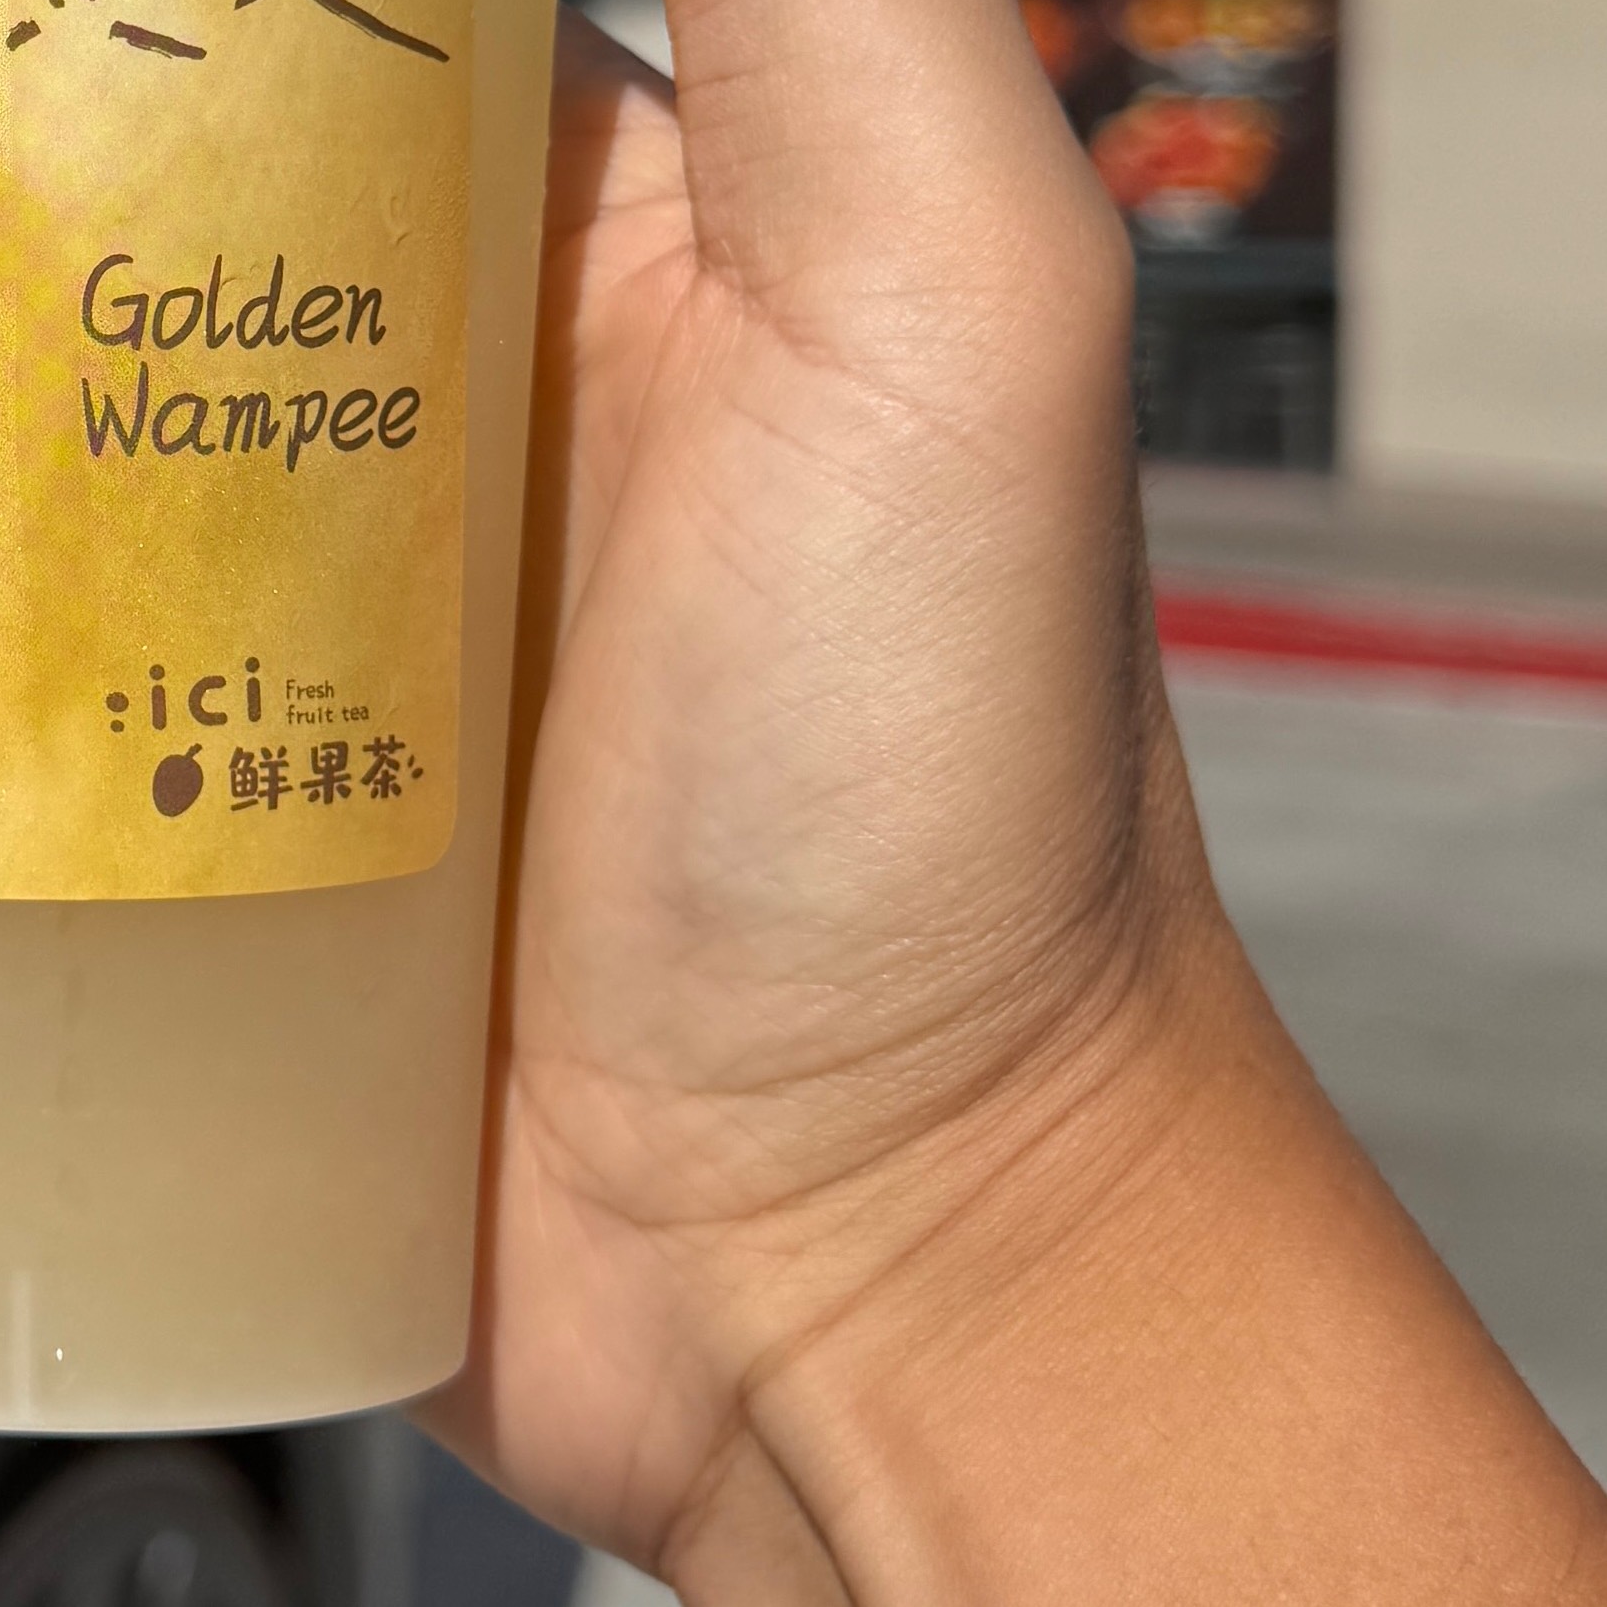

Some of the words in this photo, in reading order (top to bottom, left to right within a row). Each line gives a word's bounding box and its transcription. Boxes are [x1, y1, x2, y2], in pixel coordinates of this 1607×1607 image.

[81, 253, 387, 351] Golden
[81, 360, 420, 473] Wampee
[149, 656, 262, 731] ici
[285, 678, 335, 701] Fresh
[285, 703, 334, 726] fruit
[341, 705, 370, 723] tea
[229, 734, 406, 811] 鲜果茶
